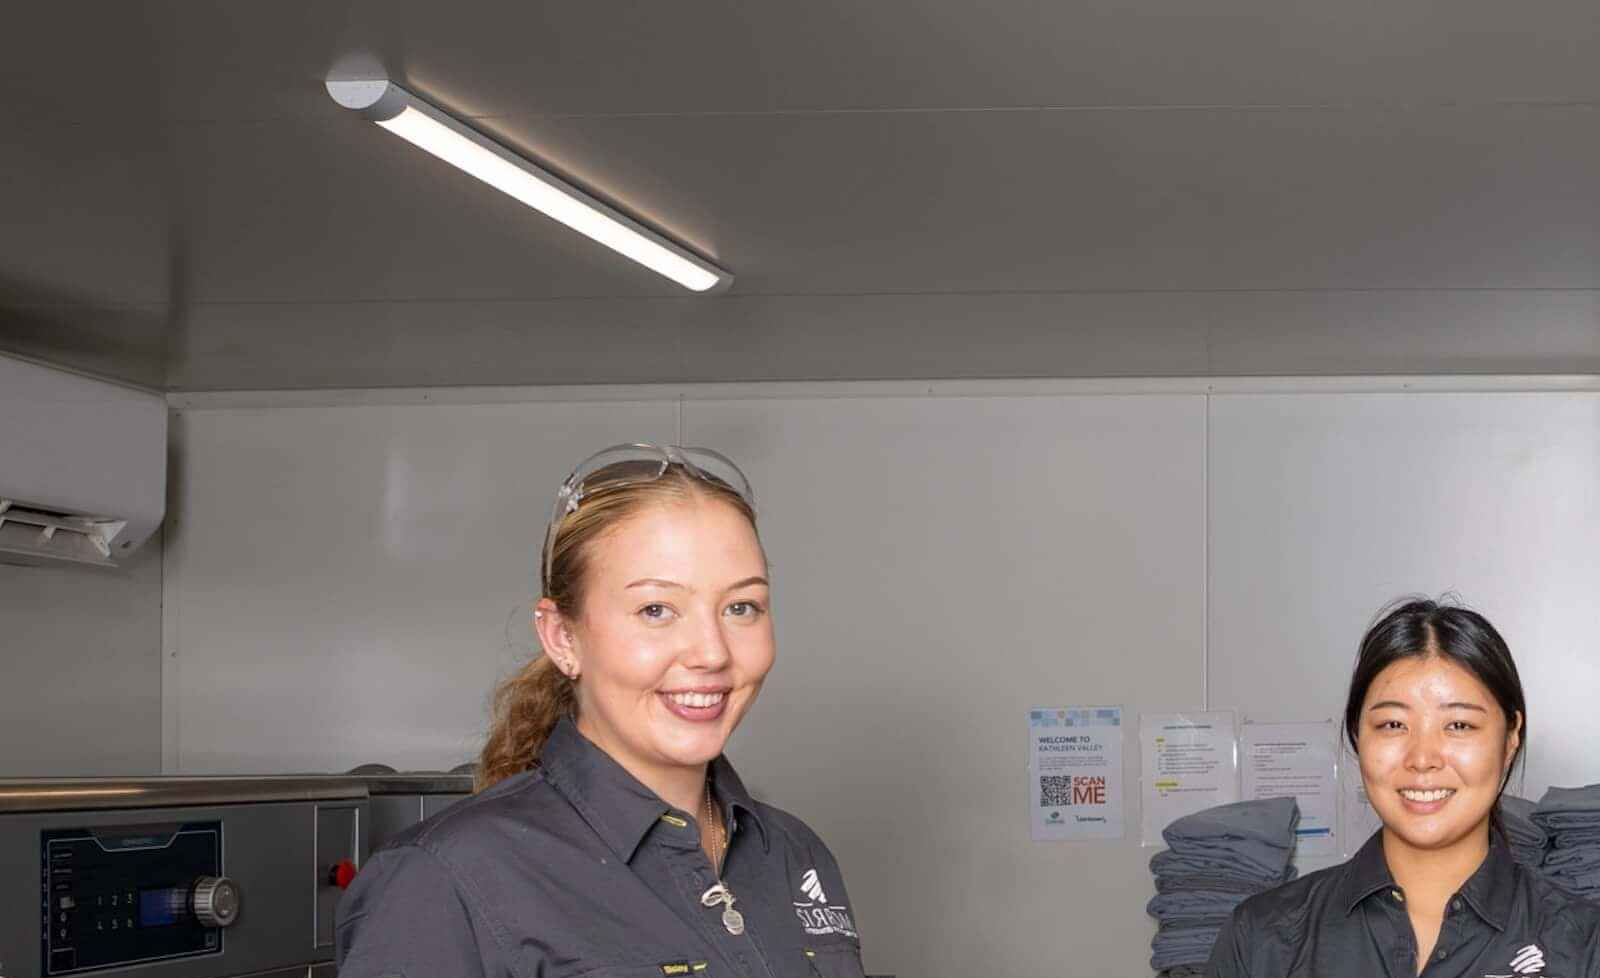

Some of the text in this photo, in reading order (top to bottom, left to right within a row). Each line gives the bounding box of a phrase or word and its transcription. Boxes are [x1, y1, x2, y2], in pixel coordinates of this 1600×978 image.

[1039, 736, 1077, 744] WELCOME
[1073, 776, 1105, 786] SCAN
[1073, 786, 1106, 805] ME
